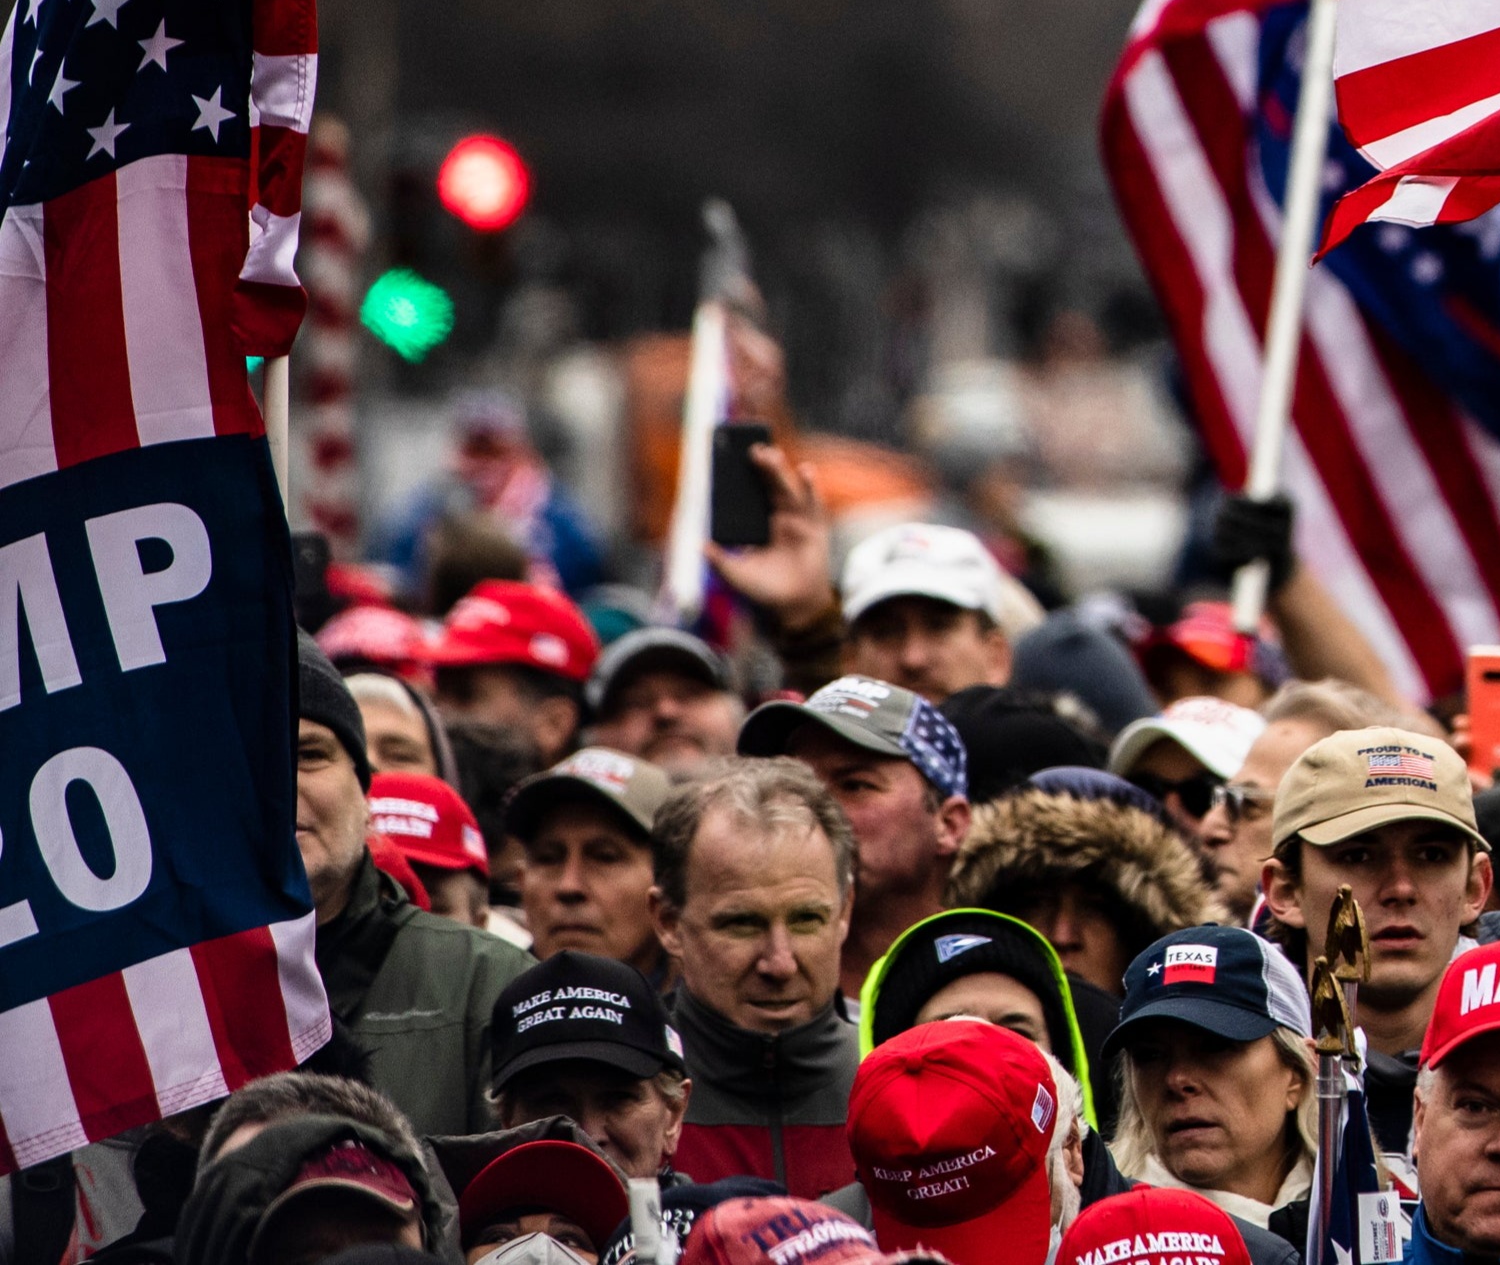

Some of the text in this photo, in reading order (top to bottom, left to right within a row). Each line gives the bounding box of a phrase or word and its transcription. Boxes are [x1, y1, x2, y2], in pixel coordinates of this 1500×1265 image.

[1357, 745, 1402, 756] PROUD
[1364, 777, 1438, 792] AMERICAN
[0, 746, 153, 948] 0
[1168, 951, 1213, 964] TEXAS
[513, 986, 632, 1018] MAKE AMERICA
[517, 1005, 624, 1033] GREAT AGAIN
[873, 1144, 997, 1183] KEEP AMERICA
[906, 1175, 970, 1200] GREAT!
[1076, 1232, 1225, 1265] MAKE AMERICA
